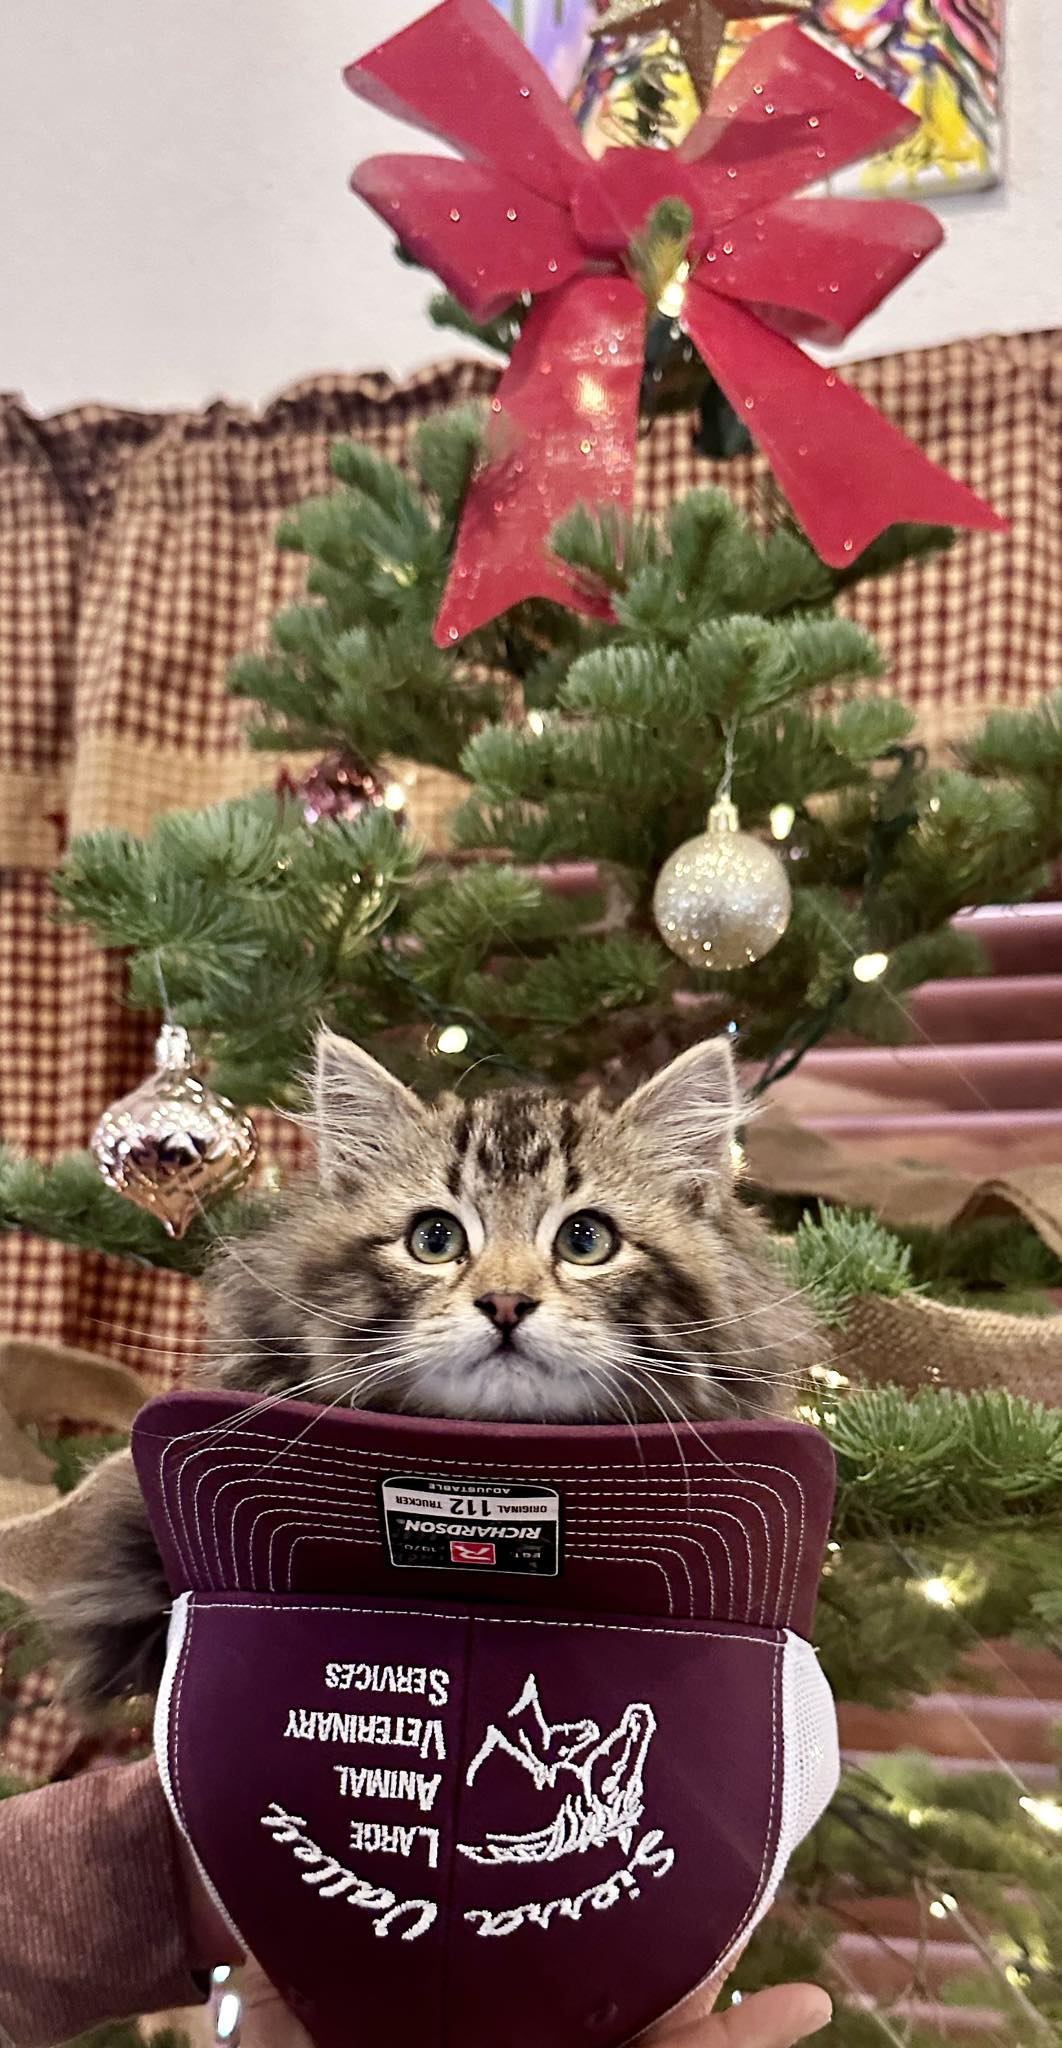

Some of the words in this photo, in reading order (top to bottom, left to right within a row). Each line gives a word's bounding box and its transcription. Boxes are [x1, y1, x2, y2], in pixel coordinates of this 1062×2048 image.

[395, 1495, 443, 1510] TRUCKER
[428, 1482, 511, 1495] ADJUSTABLE
[449, 1498, 492, 1516] 112
[497, 1504, 547, 1514] ORIGINAL
[404, 1519, 542, 1540] RICHARDSON
[325, 1662, 450, 1707] SERVICES
[283, 1709, 447, 1760] VETERINARY
[333, 1765, 442, 1811] ANIMAL
[349, 1820, 440, 1869] LARGE
[260, 1802, 438, 1942] Valley
[464, 1829, 675, 1938] Sierra
